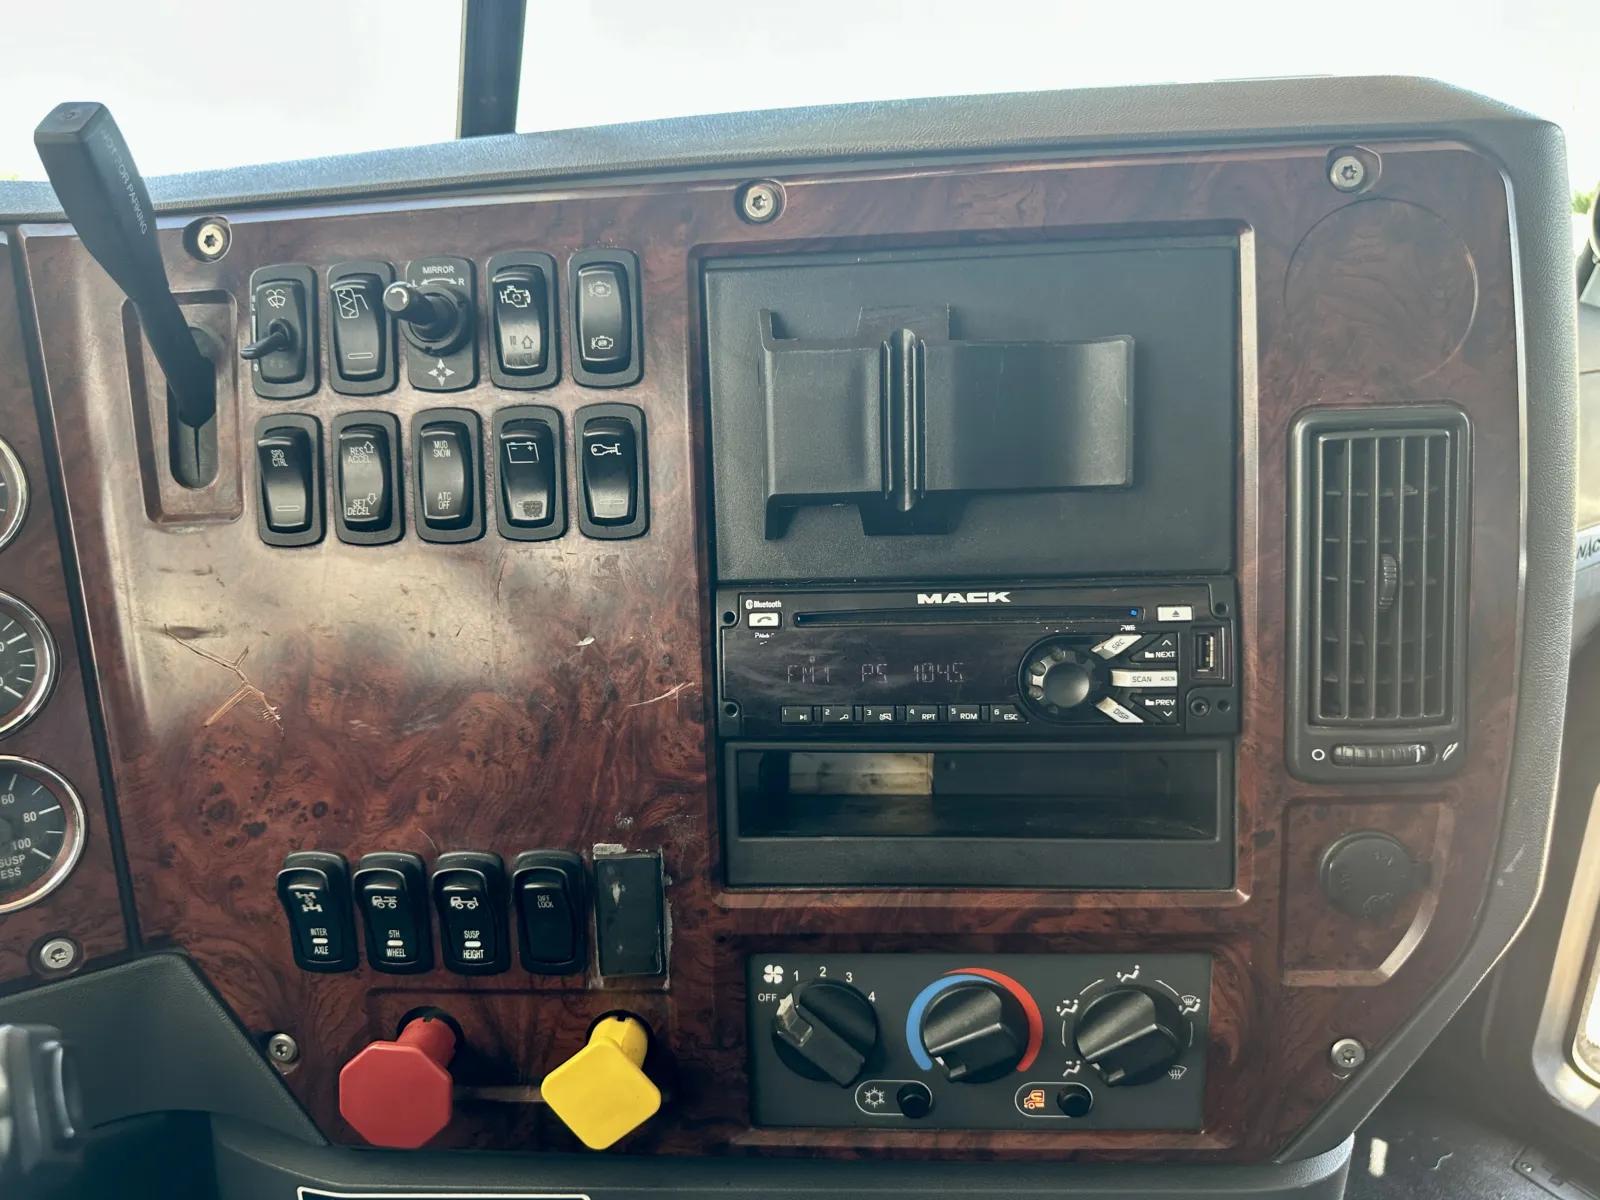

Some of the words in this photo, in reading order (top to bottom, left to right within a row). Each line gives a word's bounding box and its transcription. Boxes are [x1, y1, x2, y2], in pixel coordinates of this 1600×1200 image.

[127, 184, 148, 235] PARKING
[422, 265, 455, 275] MIRROR
[458, 278, 465, 286] R
[433, 440, 449, 449] MUD
[270, 449, 284, 459] SPD
[349, 447, 365, 457] RES
[433, 449, 451, 458] SNOW
[272, 459, 288, 467] CTRL
[438, 491, 452, 500] ATC
[352, 499, 366, 508] SET
[438, 501, 450, 510] OFF
[347, 507, 370, 516] DECEL
[917, 591, 1011, 605] MACK
[753, 600, 782, 609] Bluetooth
[1111, 638, 1126, 651] SRC
[922, 713, 936, 721] RPT
[1003, 713, 1018, 721] ESC
[1112, 708, 1130, 720] DISP
[1, 793, 15, 805] 60
[23, 811, 37, 823] 80
[12, 837, 31, 851] 100
[537, 901, 553, 909] LOCK
[310, 928, 328, 936] INTER
[388, 930, 400, 938] 5TH
[463, 930, 480, 939] SUSP
[314, 946, 329, 955] AXLE
[386, 948, 406, 957] WHEEL
[463, 949, 484, 959] HEIGHT
[793, 970, 799, 982] 1
[819, 966, 827, 977] 2
[845, 972, 853, 983] 3
[757, 993, 777, 1003] OFF
[868, 991, 876, 1003] 4
